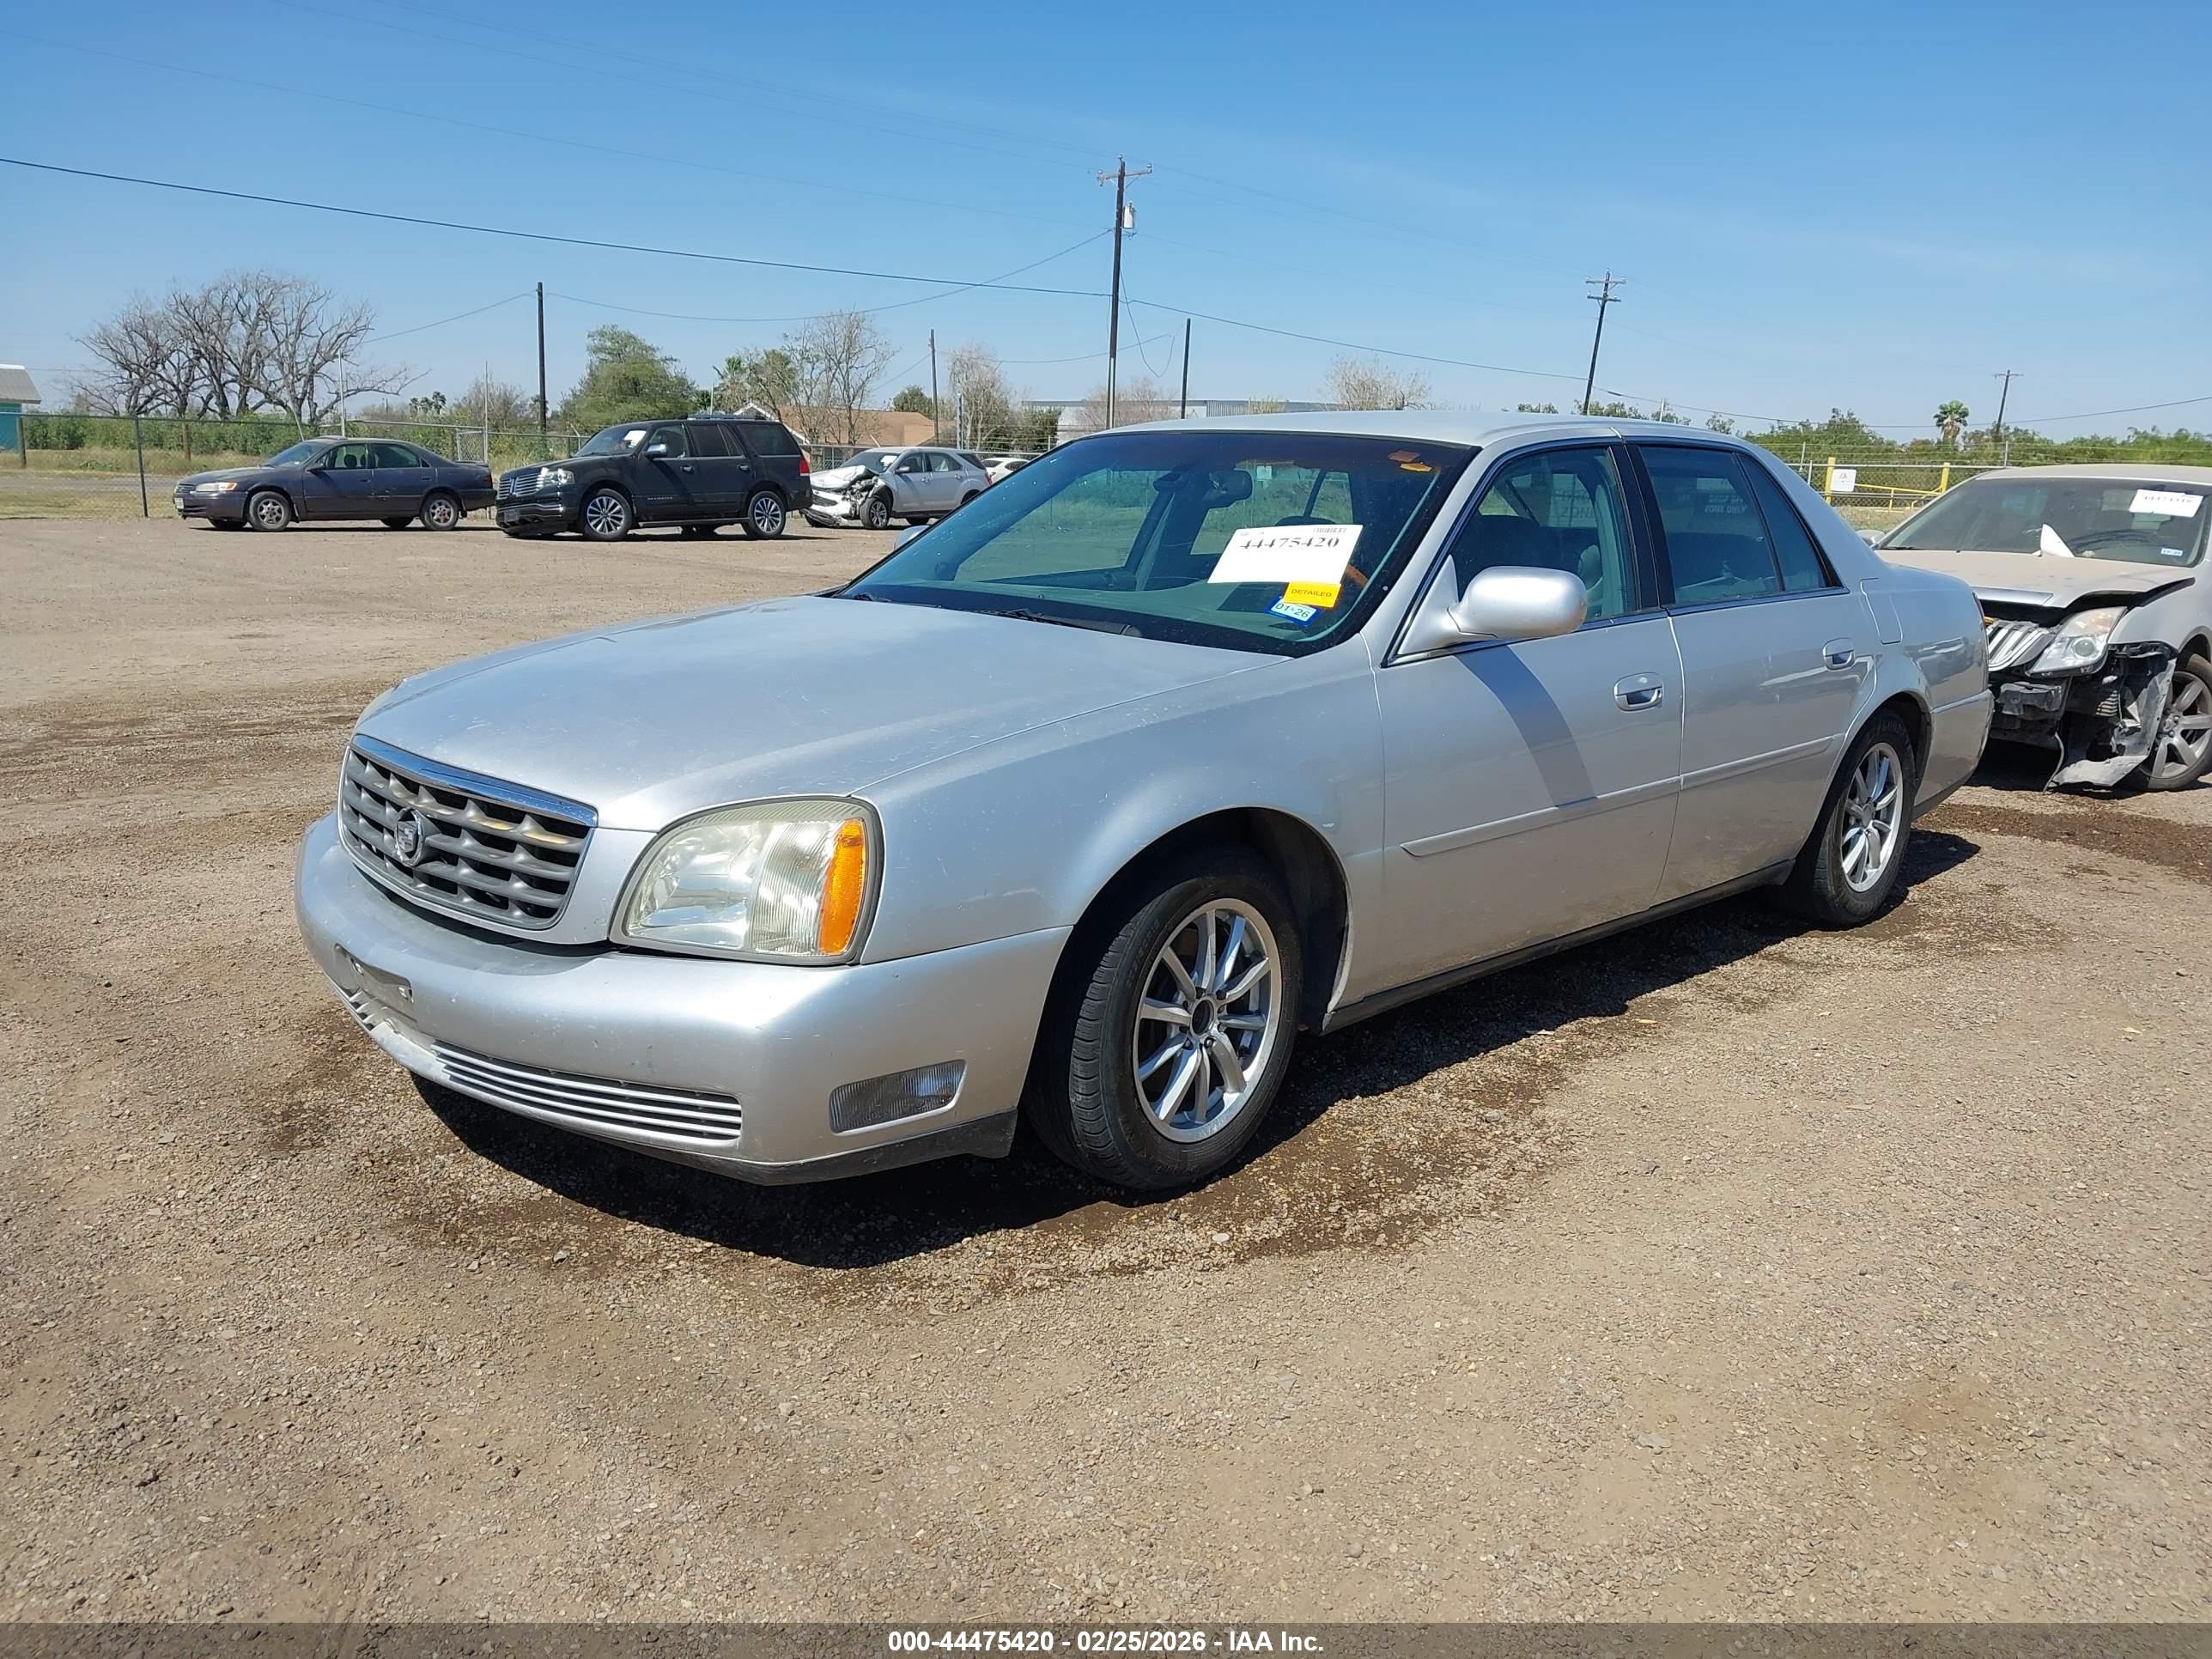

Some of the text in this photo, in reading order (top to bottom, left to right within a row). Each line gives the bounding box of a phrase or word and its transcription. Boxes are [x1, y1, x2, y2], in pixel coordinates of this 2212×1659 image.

[1239, 537, 1340, 549] 44475420
[1291, 588, 1332, 598] DETAILED
[1275, 603, 1310, 618] 01 26
